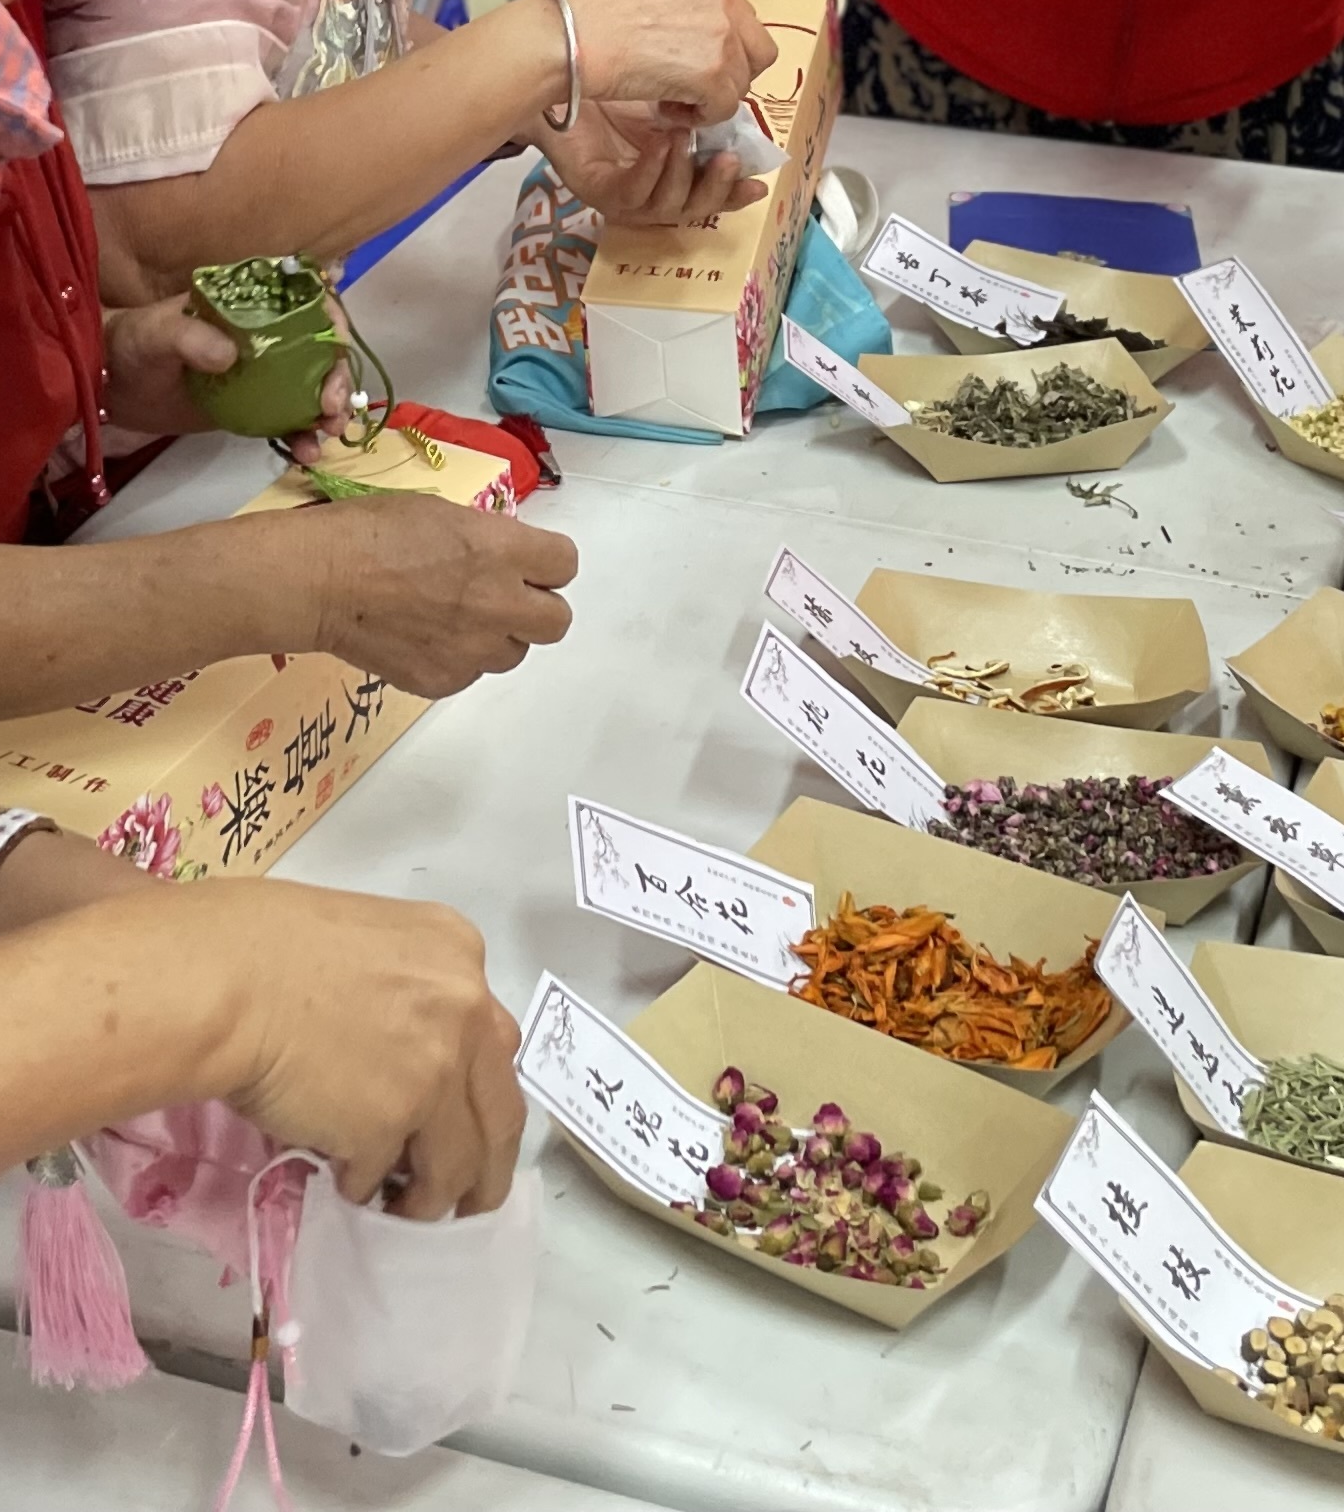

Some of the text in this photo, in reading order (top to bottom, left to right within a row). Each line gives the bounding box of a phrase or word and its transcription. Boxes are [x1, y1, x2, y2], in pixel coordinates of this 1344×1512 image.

[896, 250, 988, 308] 苦丁茶
[1228, 302, 1295, 397] 茉莉花
[798, 698, 887, 790] 桃花
[634, 862, 754, 936] 百合花
[585, 1065, 709, 1176] 玫瑰花
[1101, 1180, 1211, 1302] 桂枝
